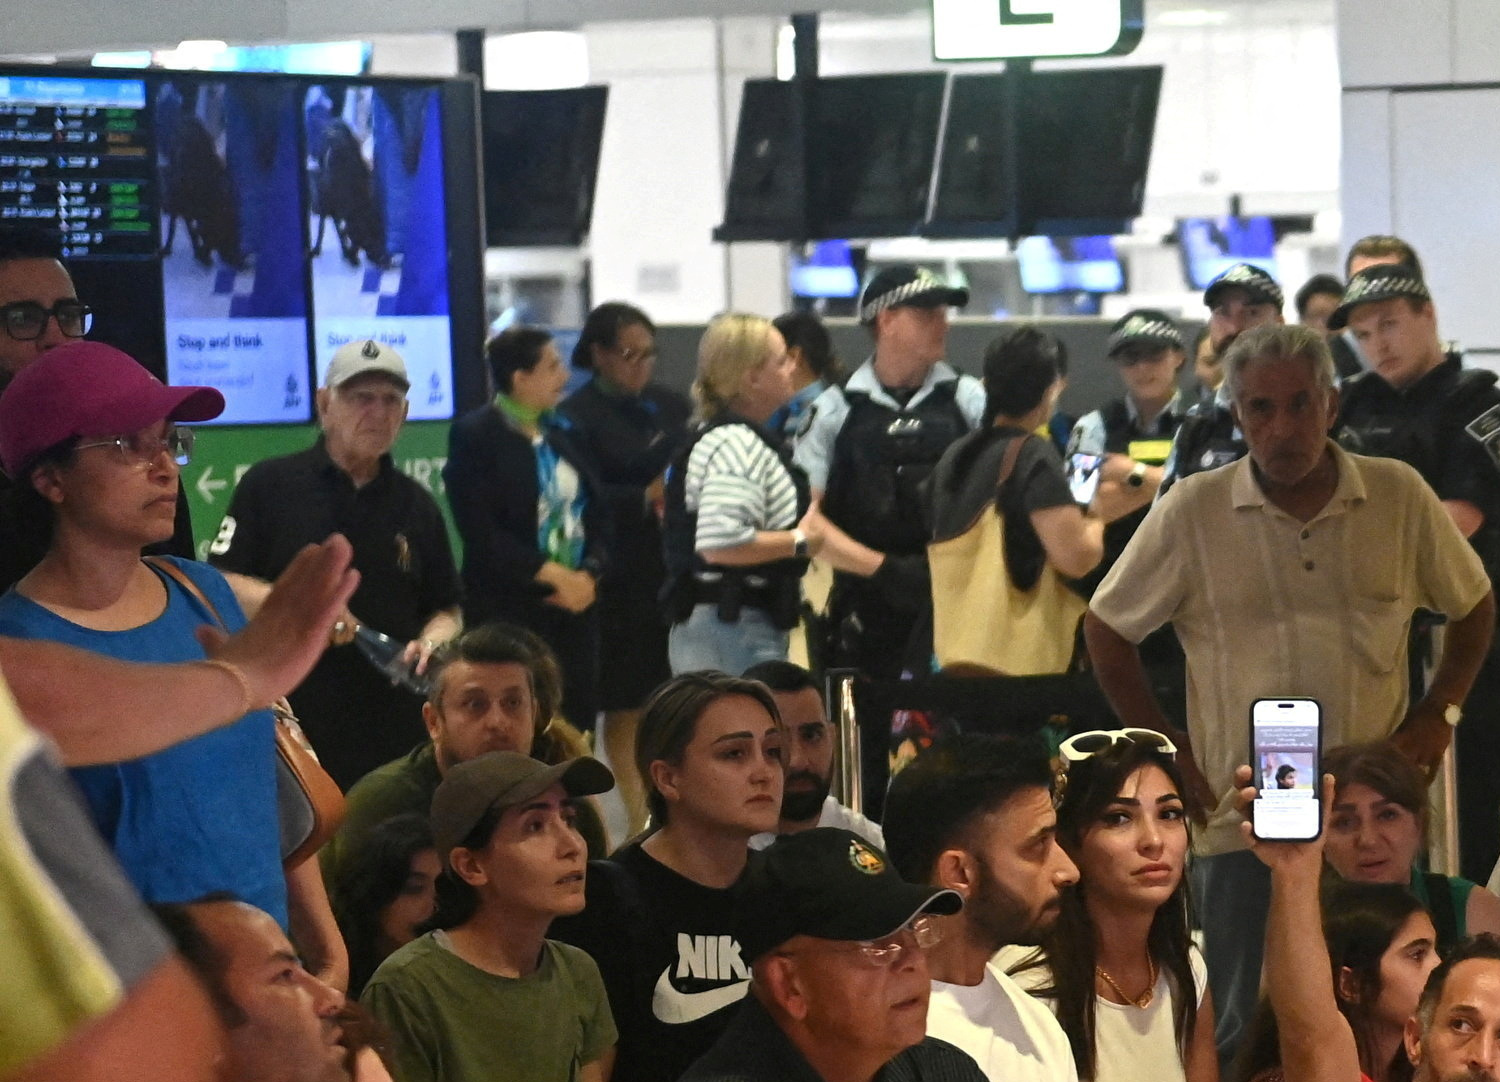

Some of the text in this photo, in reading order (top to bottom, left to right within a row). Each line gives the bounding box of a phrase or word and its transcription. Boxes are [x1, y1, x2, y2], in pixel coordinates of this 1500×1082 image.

[208, 332, 231, 348] and
[234, 332, 263, 348] think
[676, 932, 753, 981] NIK
